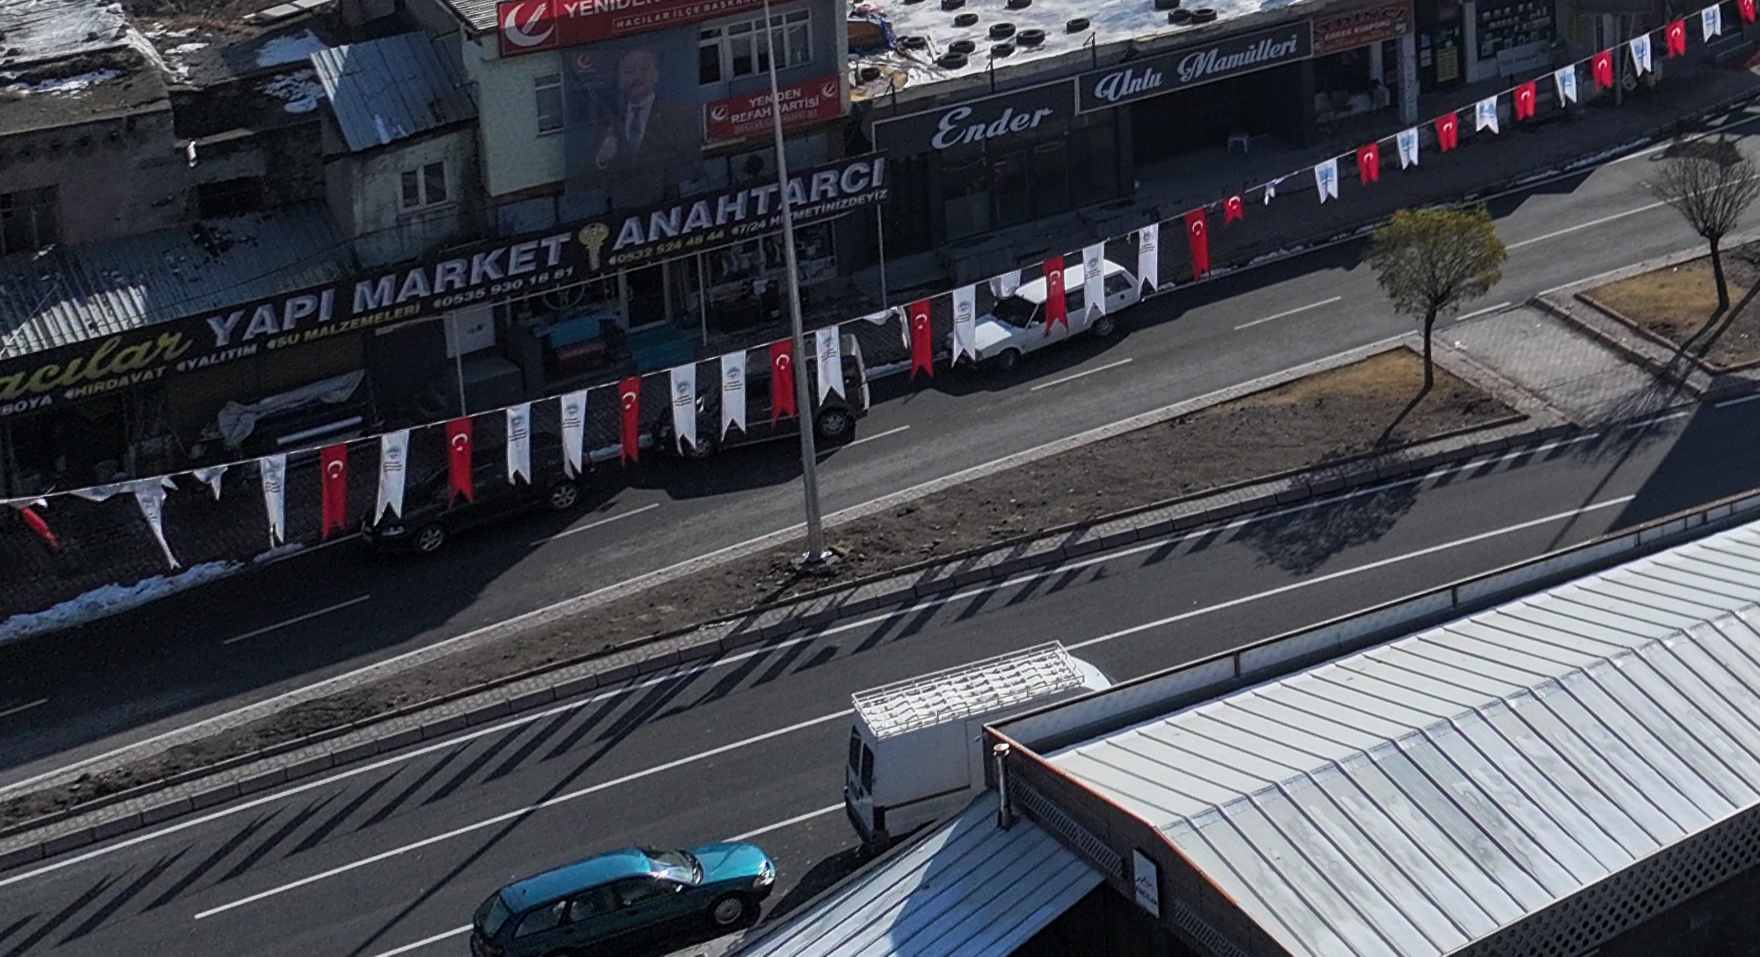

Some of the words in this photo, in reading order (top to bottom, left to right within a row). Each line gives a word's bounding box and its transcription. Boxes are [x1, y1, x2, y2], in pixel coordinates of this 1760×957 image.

[616, 12, 670, 29] HACILAR
[748, 88, 802, 108] YENDEN
[931, 106, 1053, 150] Ender
[1094, 67, 1162, 102] Unlu
[1178, 34, 1298, 82] Mamülleri
[731, 107, 772, 124] REFAH
[777, 95, 819, 113] ARTİSİ
[617, 247, 653, 263] 0532
[656, 239, 682, 255] 524
[0, 331, 193, 399] acılar
[206, 289, 335, 347] YAPI
[353, 232, 571, 314] MARKET
[612, 157, 885, 251] ANAHTARCI
[1, 396, 53, 416] BOYA
[73, 366, 167, 398] HIRDAVAT
[187, 344, 258, 370] YALITIM
[276, 333, 300, 348] SU
[303, 303, 420, 342] MALZEMELERİ
[441, 288, 486, 307] 0535
[490, 278, 524, 295] 930
